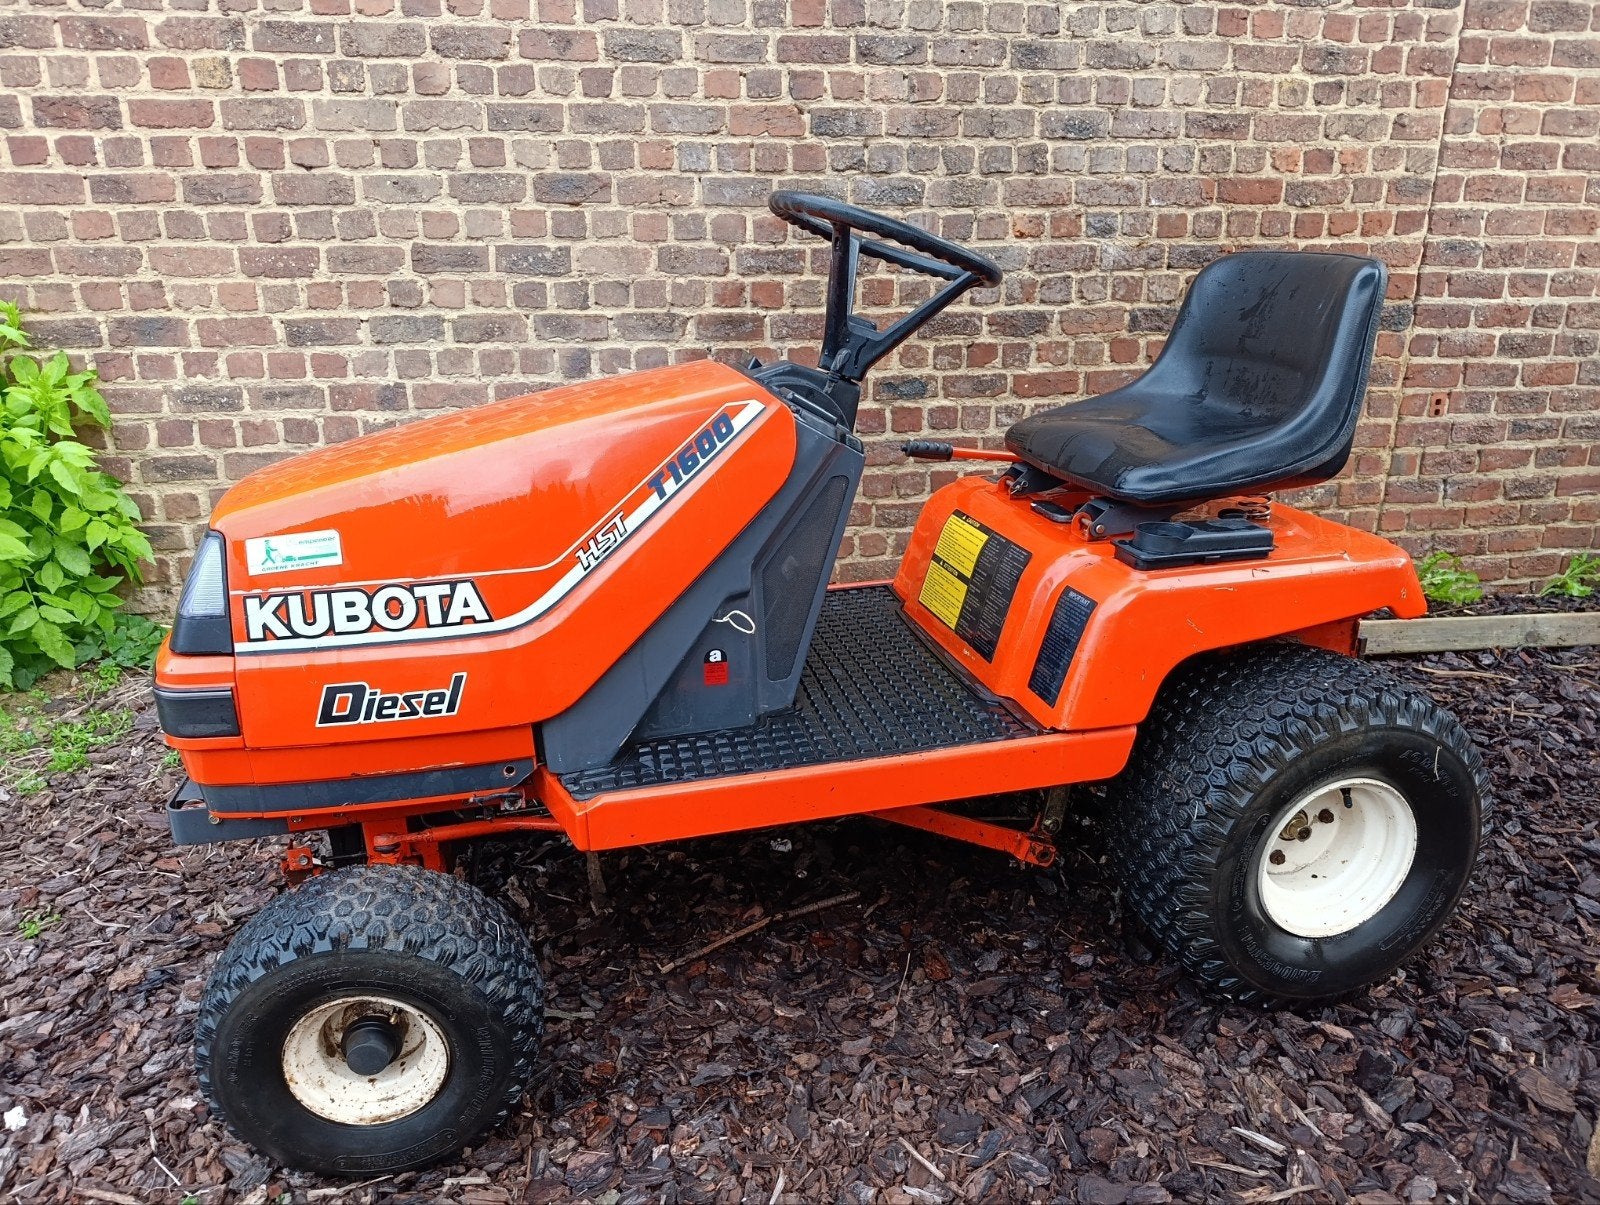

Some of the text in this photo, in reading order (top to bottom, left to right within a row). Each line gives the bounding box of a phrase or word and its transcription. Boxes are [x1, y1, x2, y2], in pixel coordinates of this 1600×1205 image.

[648, 412, 735, 500] T1600
[290, 560, 319, 569] KRACHT
[575, 511, 628, 572] HST
[244, 580, 493, 642] KUBOTA
[709, 650, 722, 662] a
[316, 672, 467, 727] Diesel
